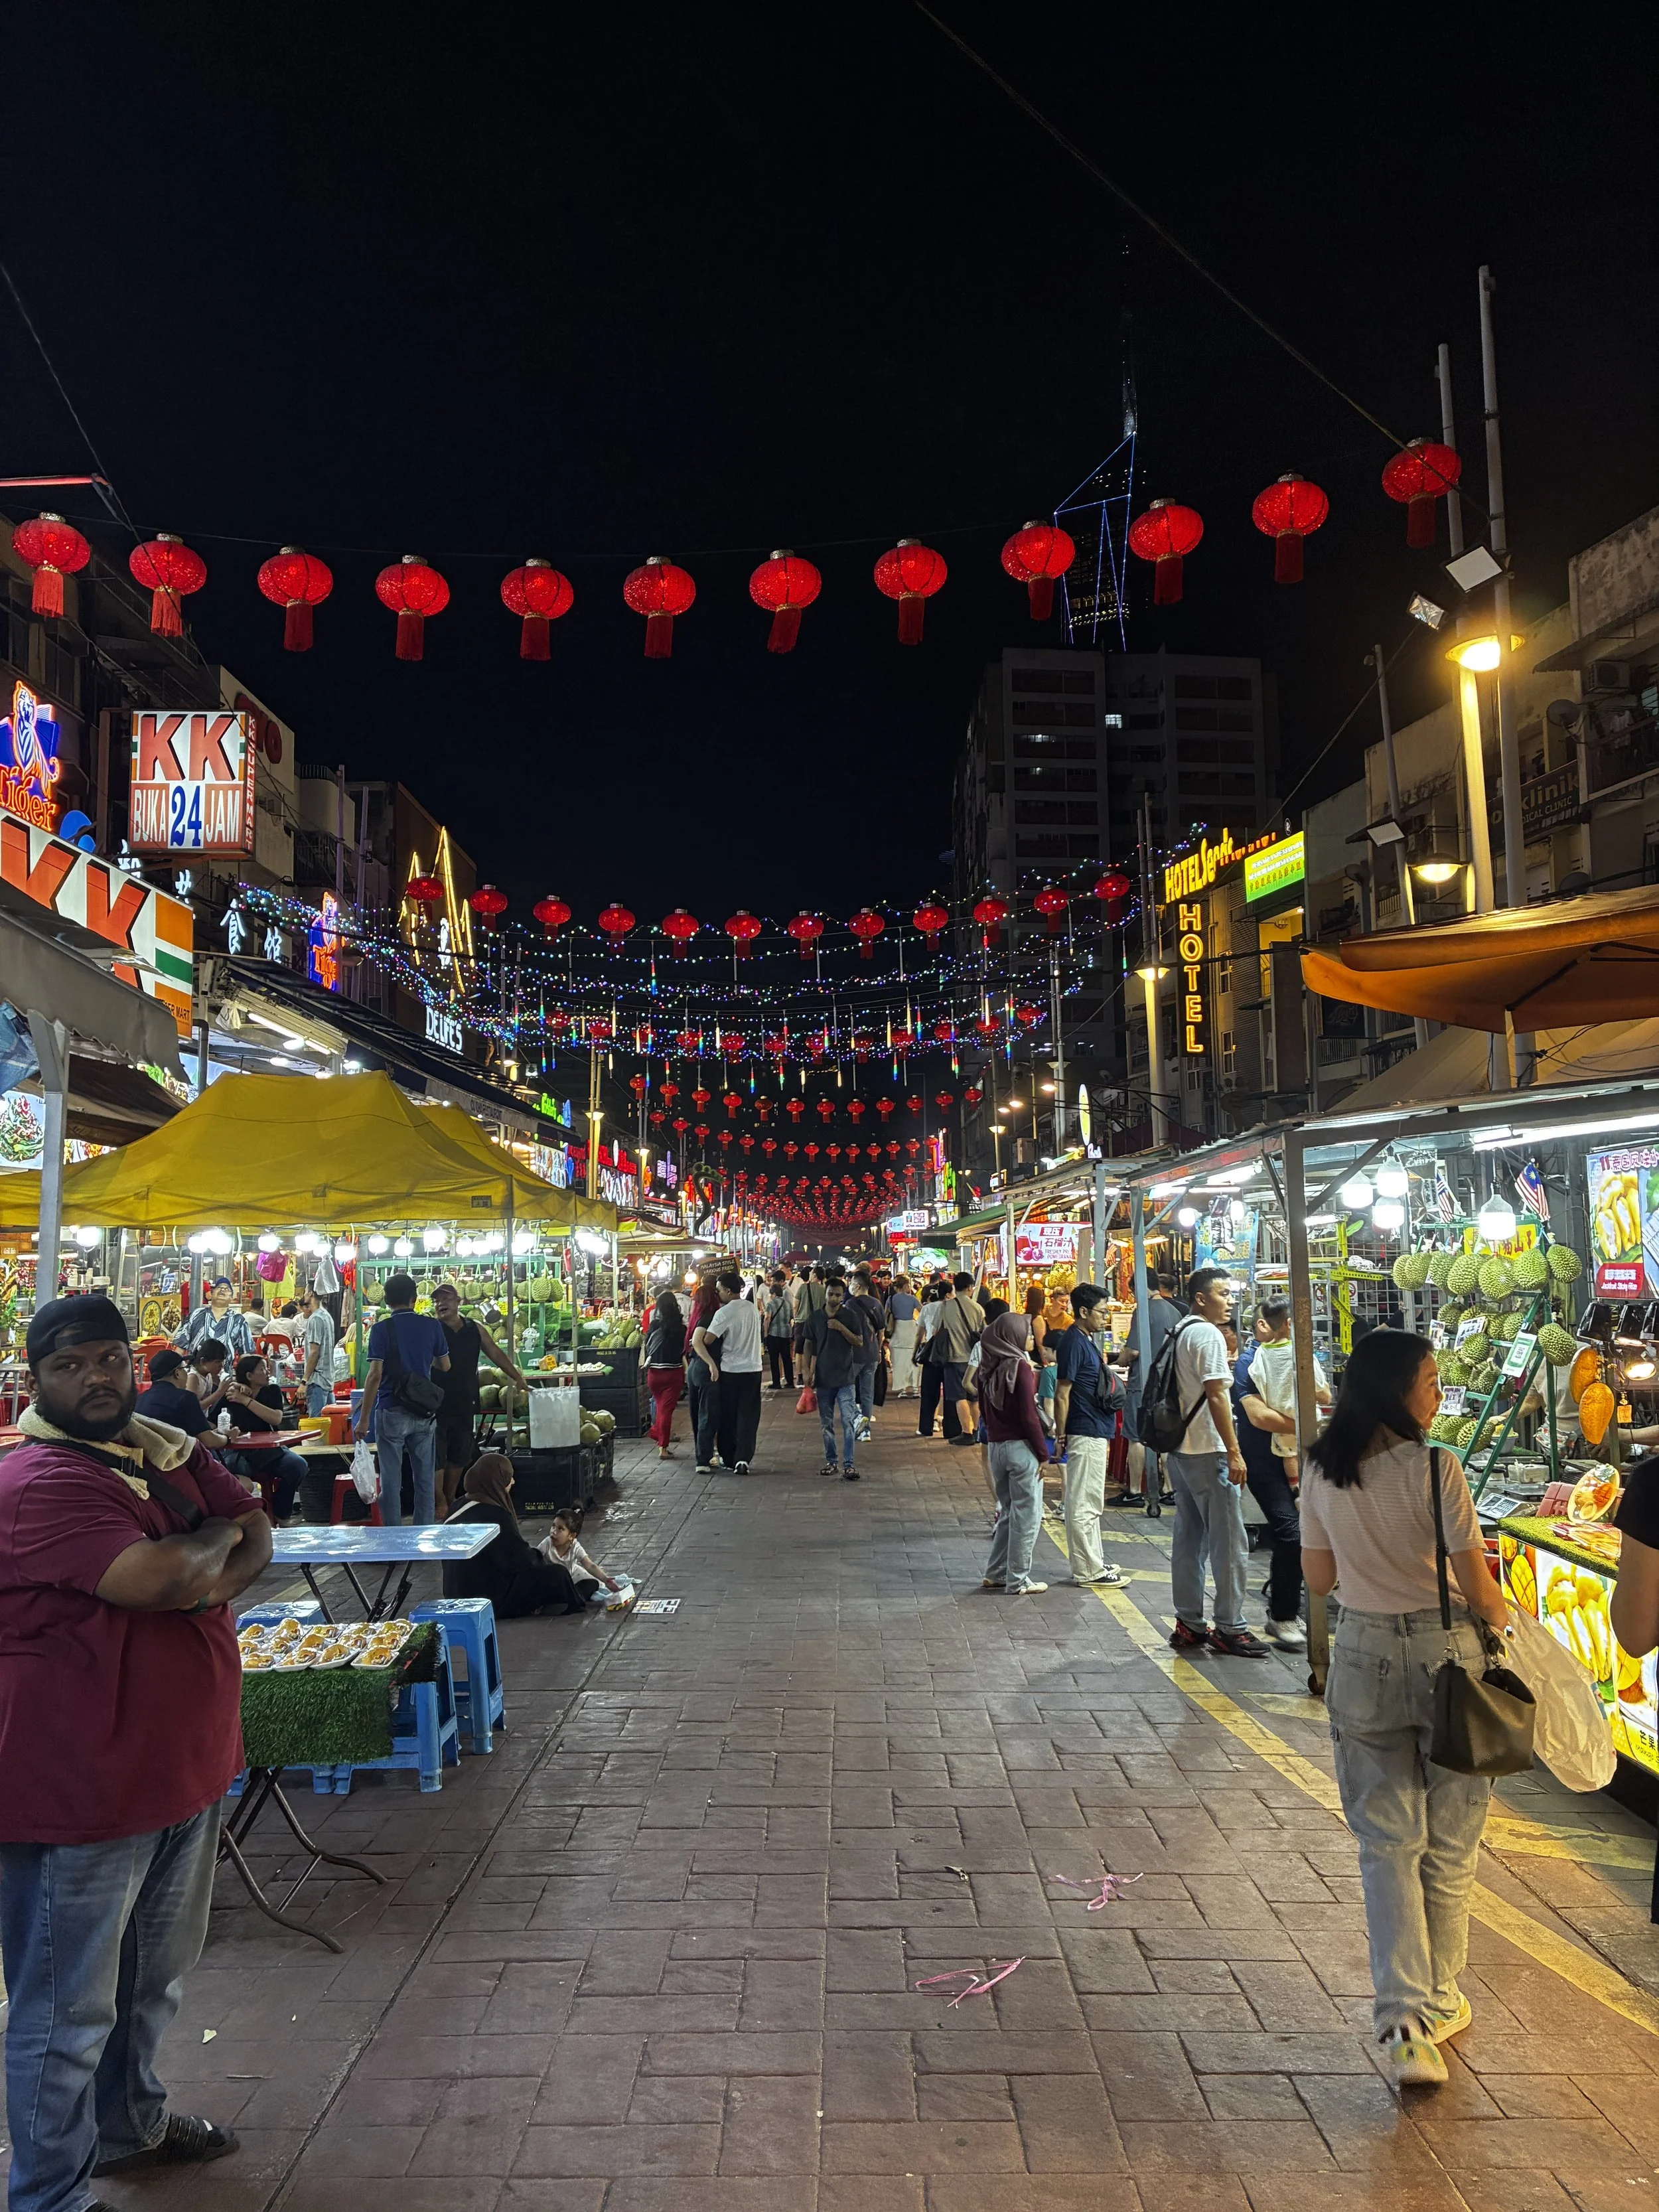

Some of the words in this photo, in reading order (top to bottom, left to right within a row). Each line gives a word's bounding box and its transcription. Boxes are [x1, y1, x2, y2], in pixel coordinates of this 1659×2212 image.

[139, 713, 238, 781] KK
[134, 789, 166, 842] BUKA
[171, 786, 202, 846] 24
[206, 790, 240, 842] JAM
[1545, 796, 1572, 814] CLINIC
[1165, 853, 1203, 903] HOTEL
[1179, 904, 1204, 1053] HOTEL
[176, 1006, 190, 1021] MART
[1640, 1730, 1656, 1751] 芒果
